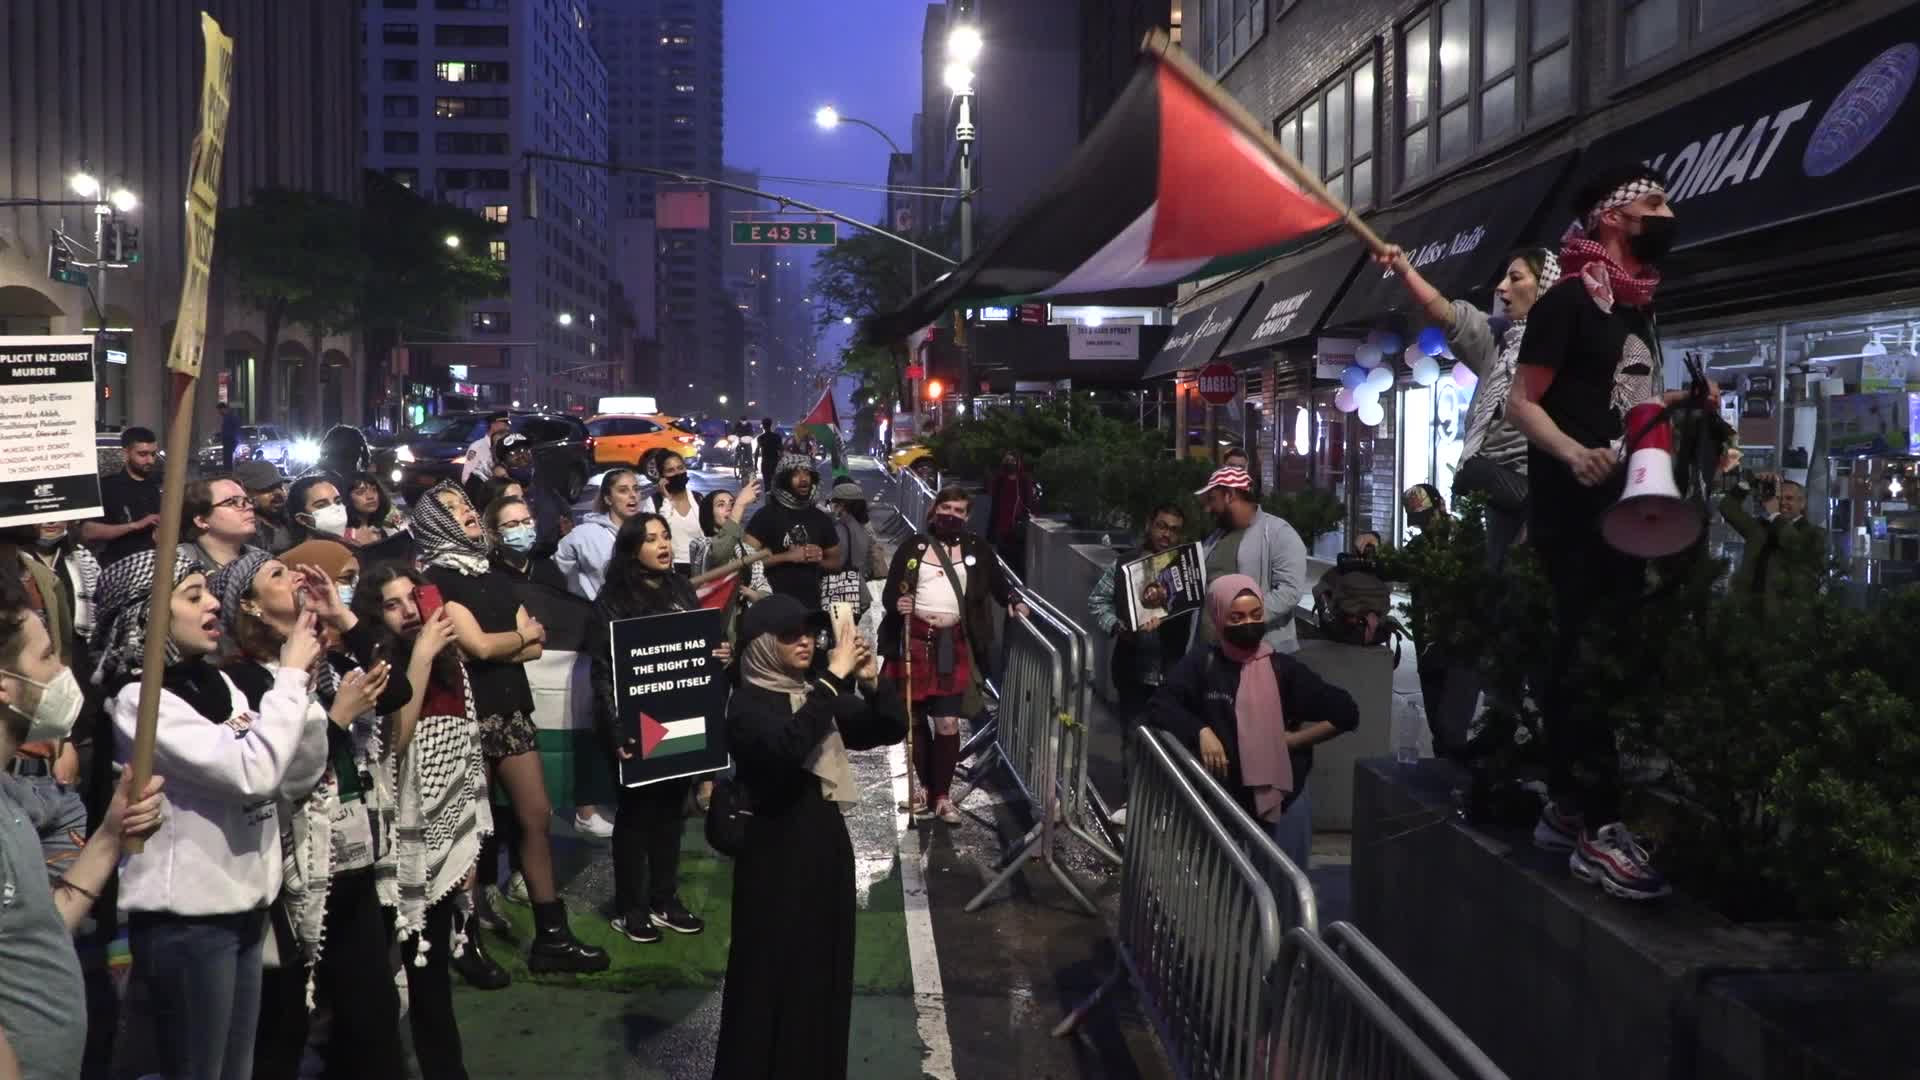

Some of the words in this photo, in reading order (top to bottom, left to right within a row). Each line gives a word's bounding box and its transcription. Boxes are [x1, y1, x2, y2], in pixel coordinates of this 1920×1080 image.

[752, 226, 761, 240] E
[767, 226, 791, 240] 43
[797, 226, 817, 241] St
[0, 353, 33, 364] PLICIT
[35, 353, 48, 362] IN
[49, 352, 89, 362] ZIONIST
[12, 367, 57, 377] MURDER
[1200, 375, 1236, 393] BAGELS
[631, 642, 682, 657] PALESTINE
[684, 639, 706, 650] HAS
[633, 665, 654, 676] THE
[657, 660, 689, 673] RIGHT
[691, 657, 706, 667] TO
[629, 681, 674, 696] DEFEND
[677, 675, 712, 690] ITSELF
